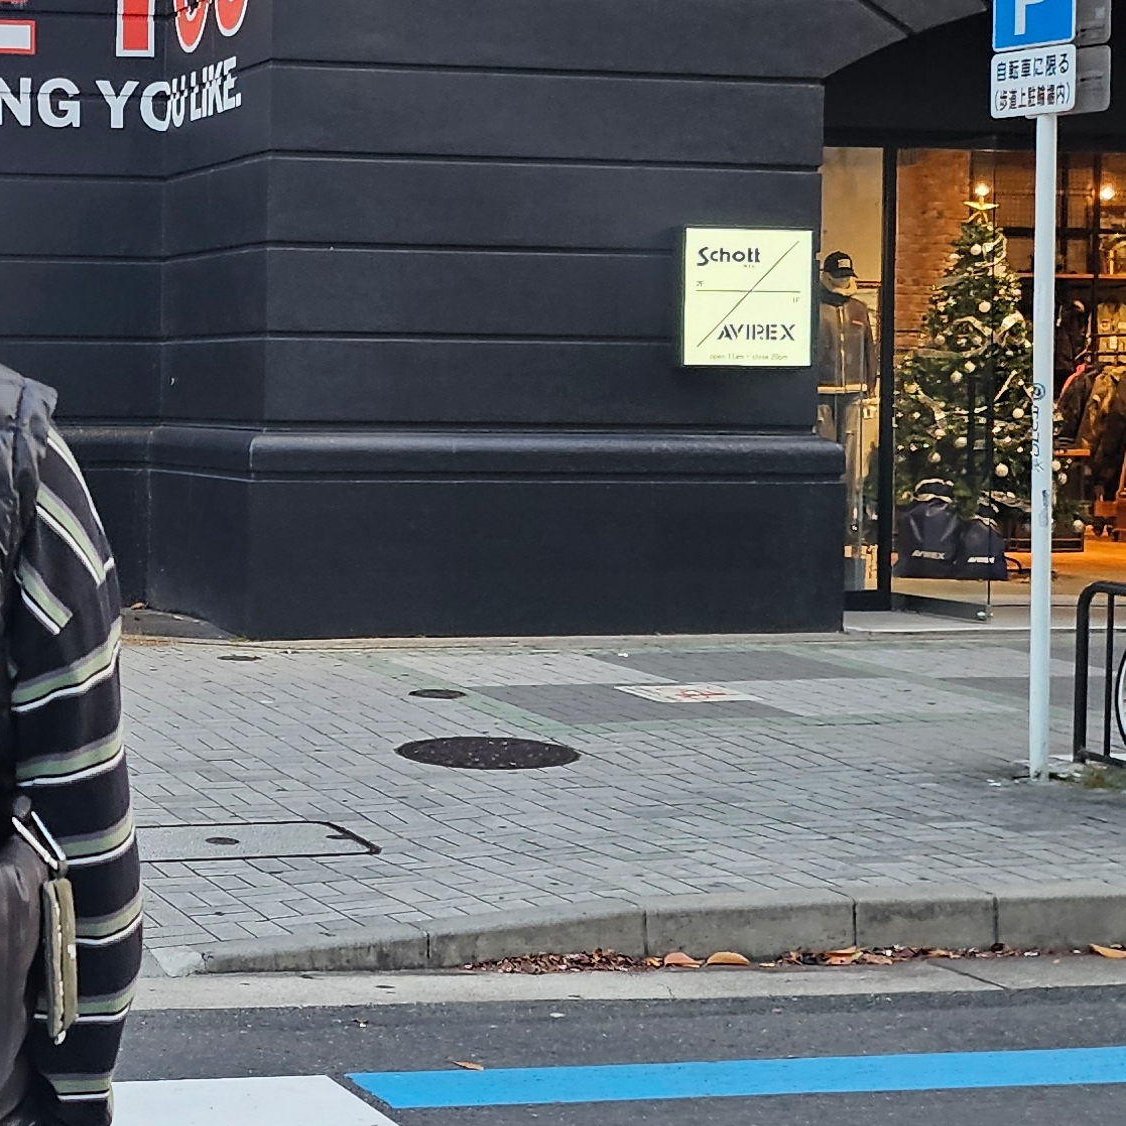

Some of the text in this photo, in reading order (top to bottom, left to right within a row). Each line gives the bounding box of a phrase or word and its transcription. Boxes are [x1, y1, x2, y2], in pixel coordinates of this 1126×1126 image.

[996, 53, 1070, 82] 自転車に限る
[95, 73, 187, 132] YOU
[696, 246, 761, 267] Schott
[717, 324, 796, 342] AVIREX
